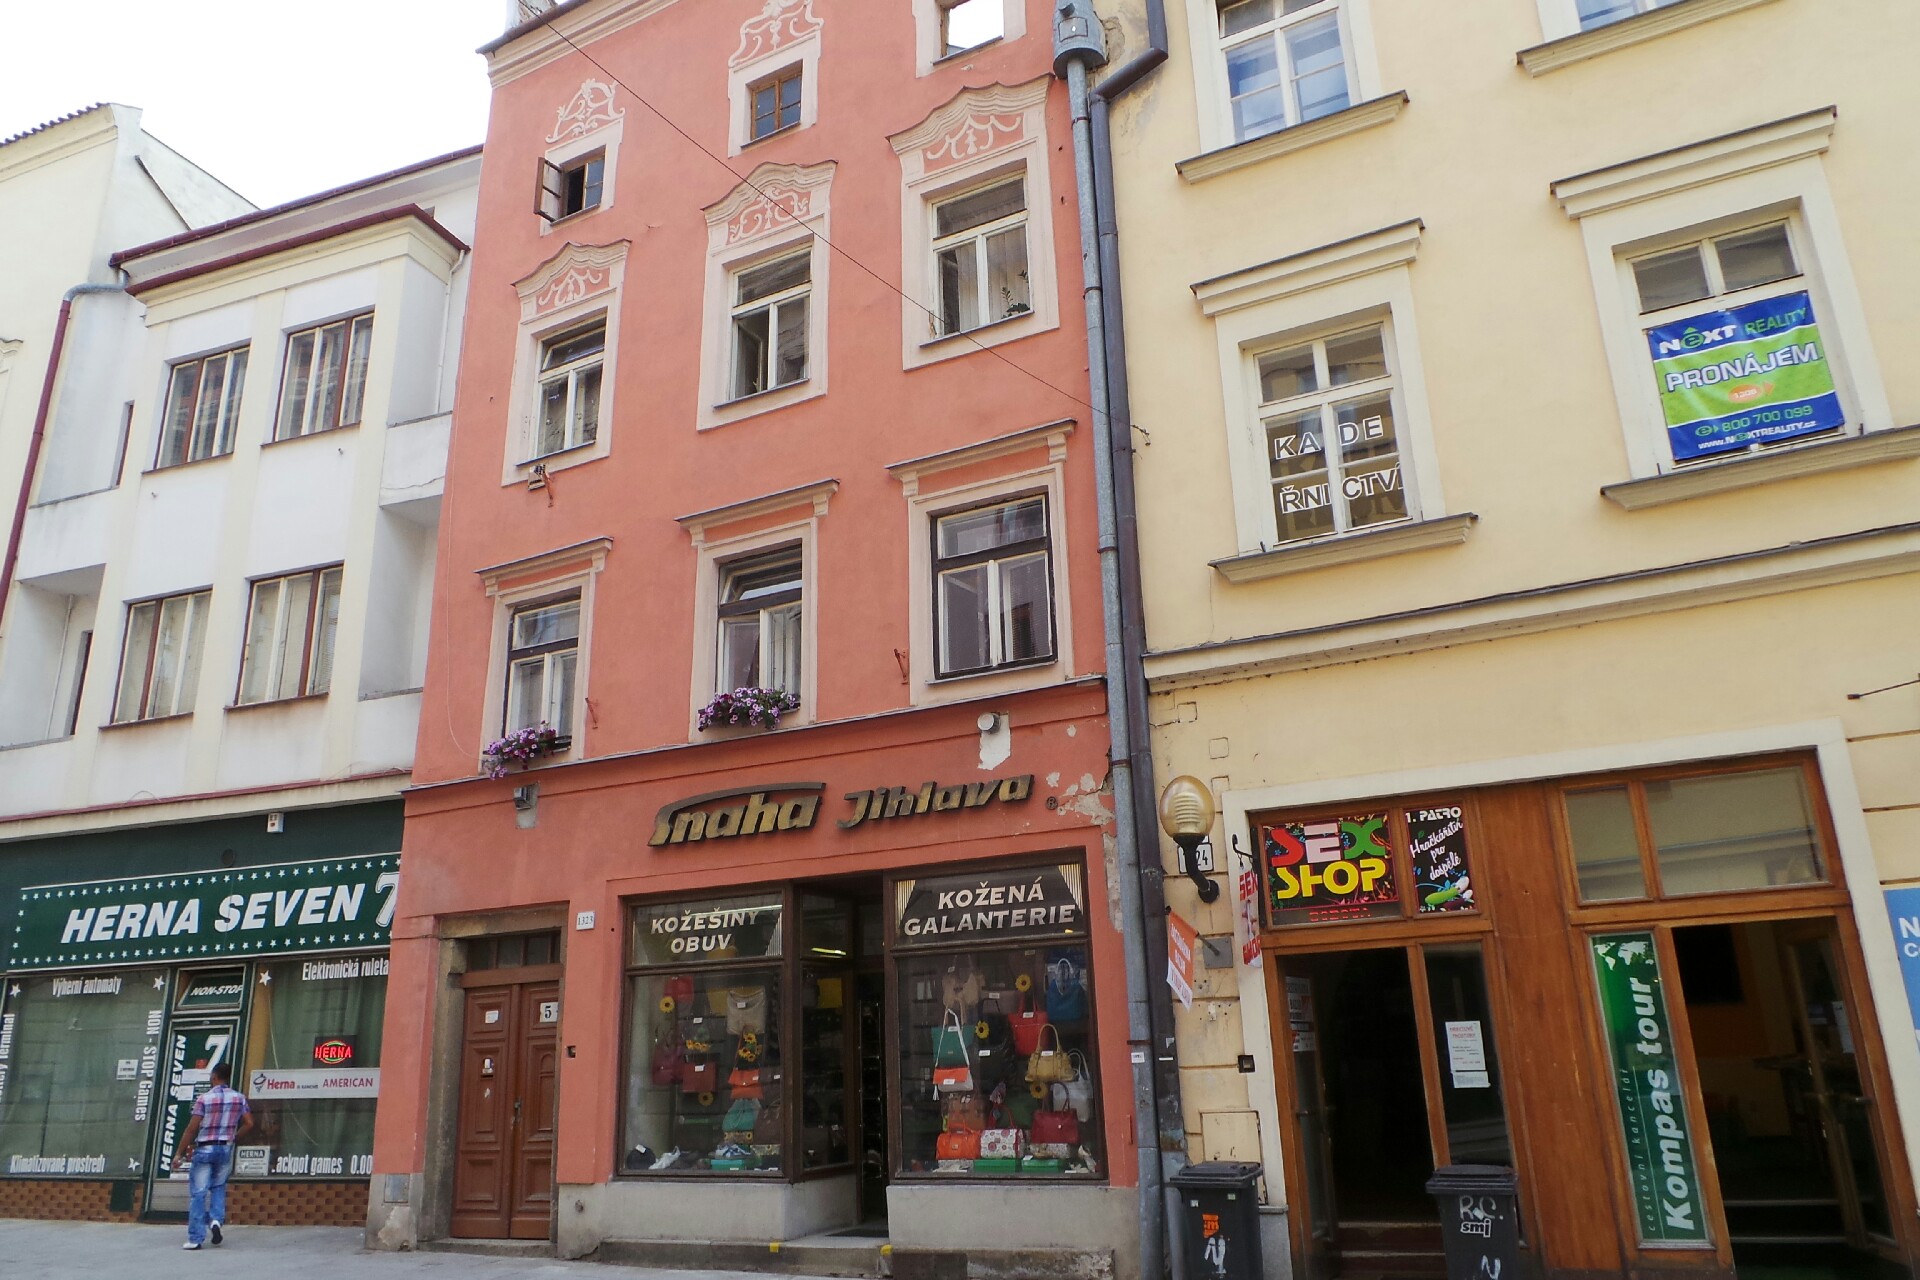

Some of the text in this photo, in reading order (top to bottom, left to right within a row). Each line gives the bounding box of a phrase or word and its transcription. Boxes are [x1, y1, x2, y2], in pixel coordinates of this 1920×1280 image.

[1744, 307, 1808, 336] REALITY
[1665, 341, 1819, 393] PRONÁJEM
[1721, 417, 1751, 433] 800
[1752, 410, 1781, 425] 700
[1784, 405, 1814, 419] 099
[647, 774, 1034, 847] Snaha Jihlava
[1405, 806, 1462, 823] 1. PATRO
[1270, 817, 1387, 867] SEX
[1430, 845, 1446, 863] pro
[1276, 857, 1387, 900] SHOP
[1430, 851, 1461, 881] dospělé
[937, 876, 1045, 910] KOŽENÁ
[1239, 870, 1258, 900] SEX
[61, 898, 201, 945] HERNA
[213, 883, 366, 933] SEVEN
[651, 906, 759, 934] KOŽEŠINY
[904, 904, 1076, 936] GALANTERIE
[670, 933, 732, 954] OBUV
[302, 957, 390, 981] Elektronická ruleta
[53, 976, 122, 998] Výherní automaty
[544, 1005, 552, 1019] 5
[314, 1046, 353, 1059] HERNA
[267, 1078, 296, 1090] Herna
[322, 1077, 374, 1088] AMERICAN
[135, 1080, 153, 1122] Games
[161, 1034, 188, 1171] HERNA SEVEN
[1629, 976, 1695, 1231] Kompas tour
[310, 1156, 343, 1176] games
